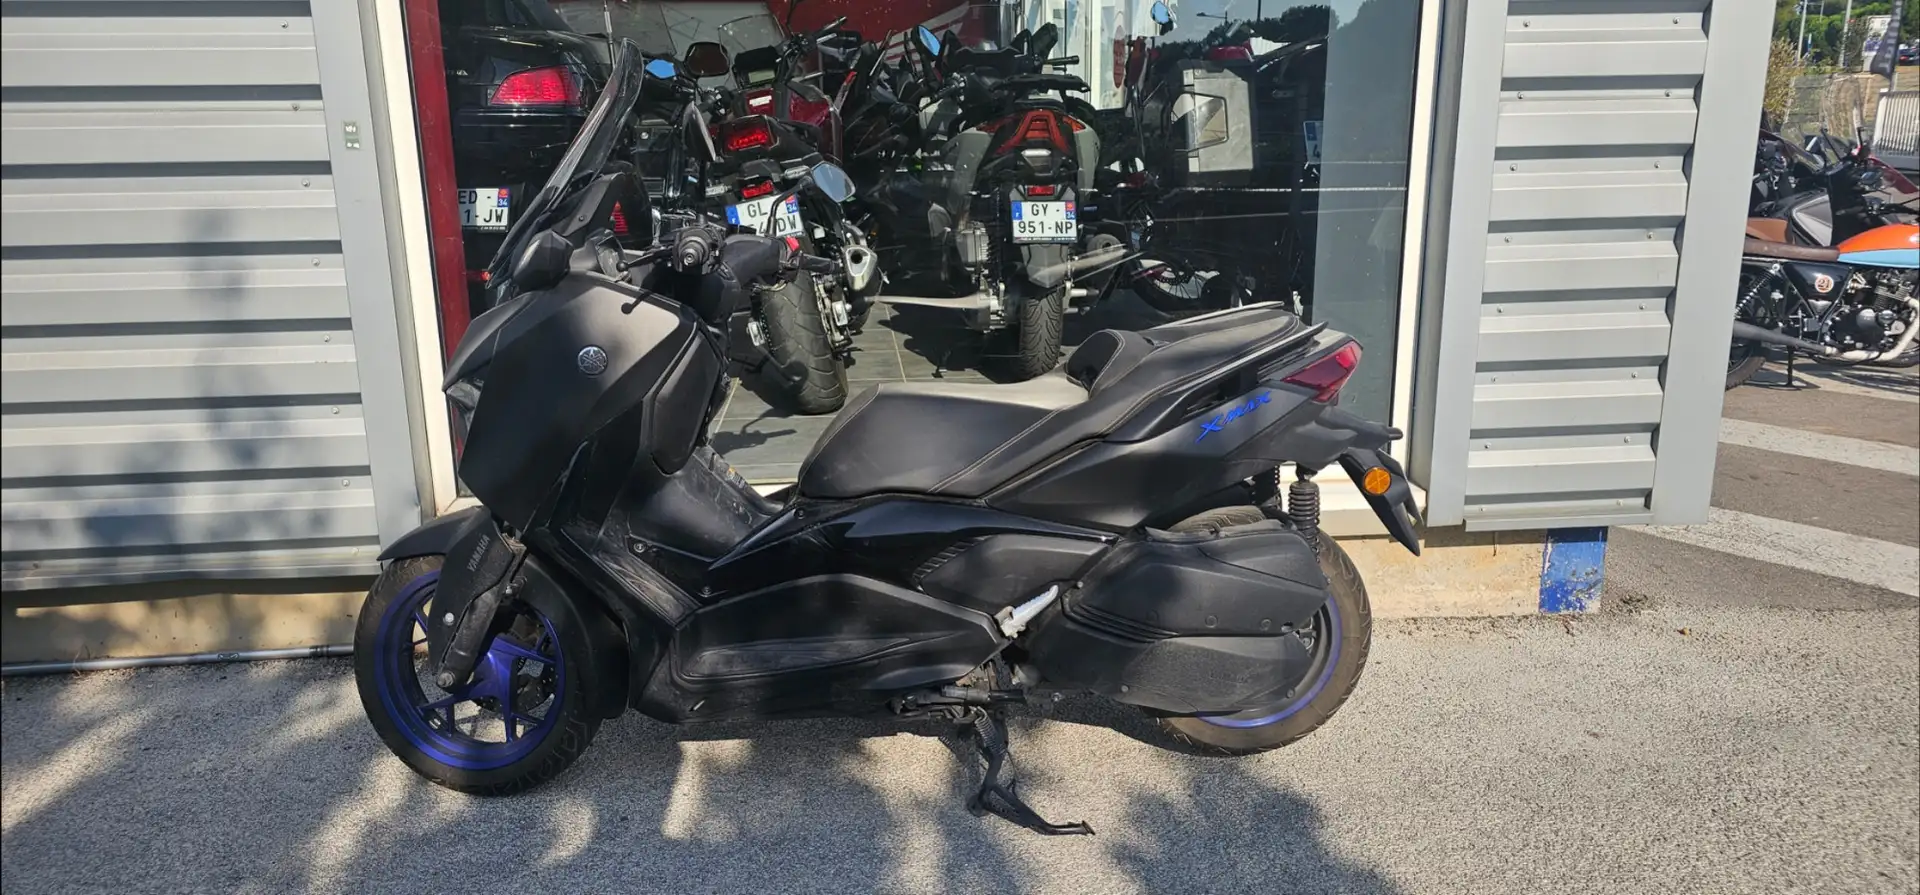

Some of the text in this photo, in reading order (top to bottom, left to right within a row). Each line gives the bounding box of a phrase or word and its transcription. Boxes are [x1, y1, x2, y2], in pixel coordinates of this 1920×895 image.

[458, 190, 478, 204] ED
[498, 198, 508, 206] 34
[747, 201, 769, 218] GL
[786, 203, 798, 213] 34
[1031, 203, 1049, 217] GY
[1066, 211, 1076, 219] 34
[1018, 221, 1073, 234] 951-NP
[466, 534, 491, 572] YAMAHA
